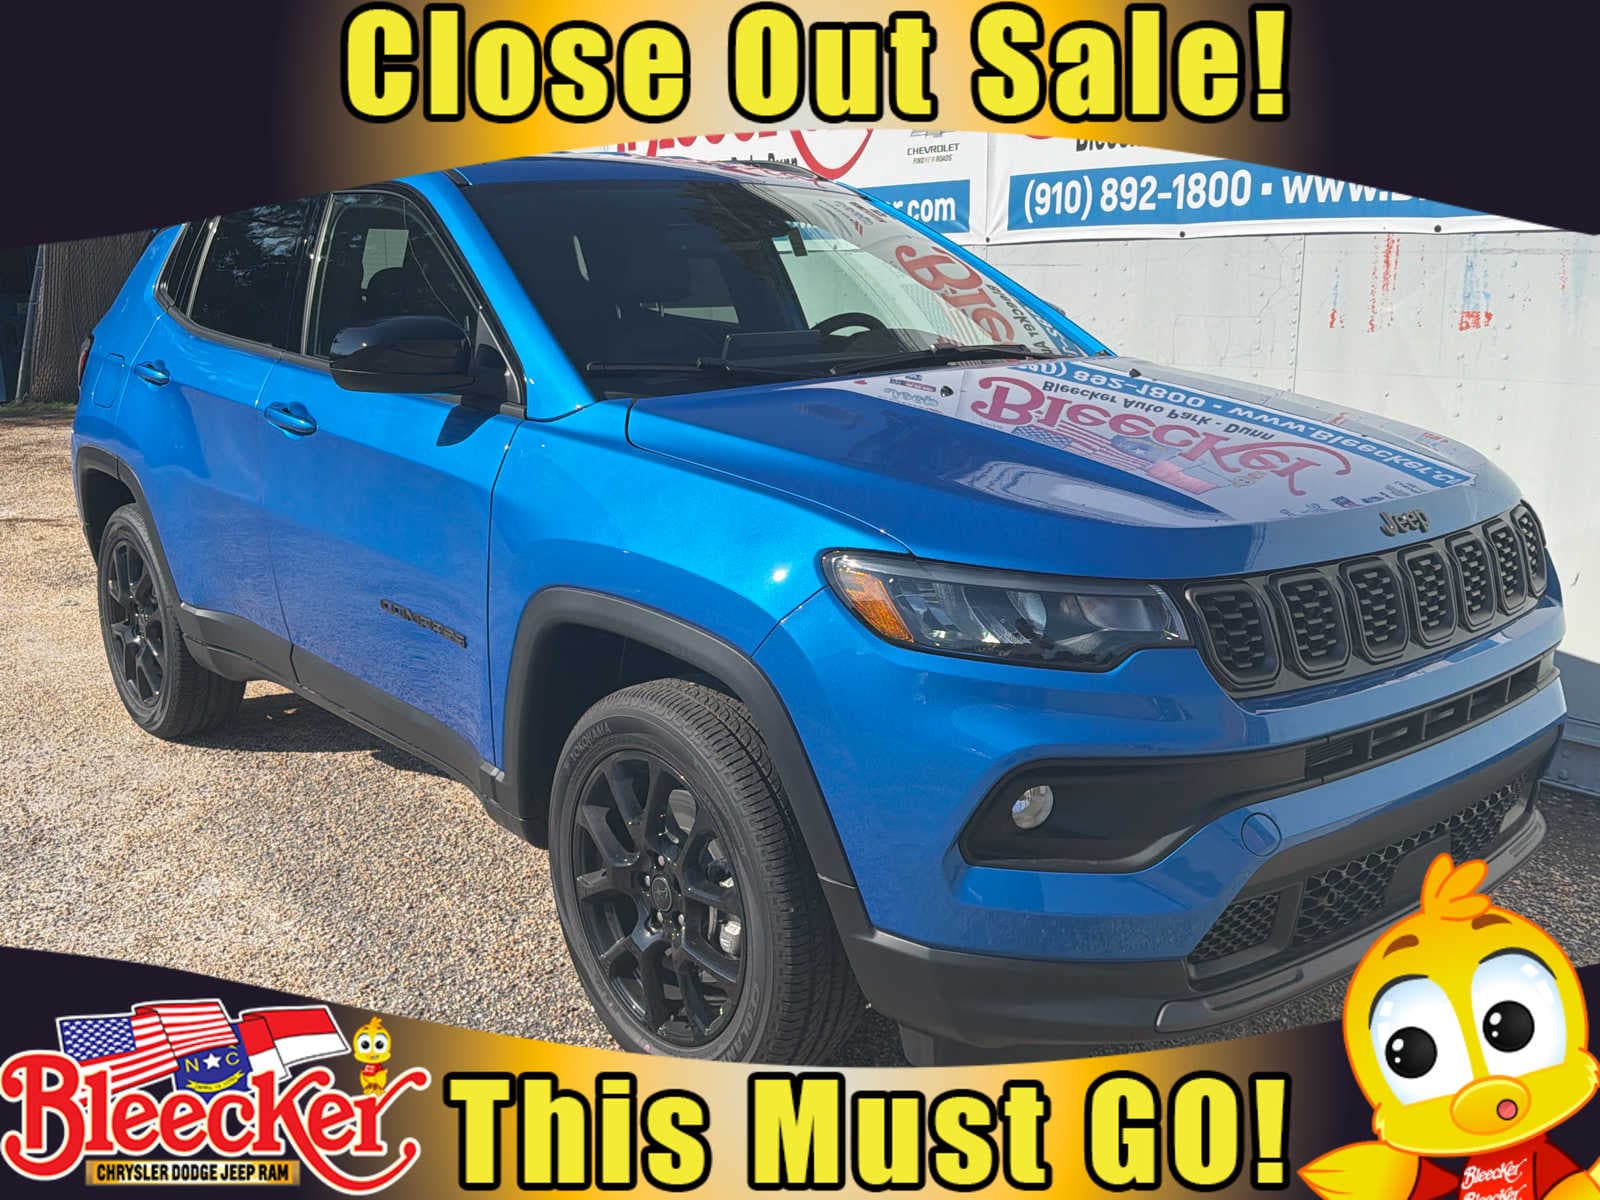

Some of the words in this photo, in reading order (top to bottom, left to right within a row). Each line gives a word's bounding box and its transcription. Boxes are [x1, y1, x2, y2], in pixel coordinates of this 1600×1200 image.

[907, 143, 960, 155] CHEVROLET
[1024, 175, 1093, 224] (910)
[1100, 169, 1252, 212] 892-1800
[1379, 509, 1430, 537] Jeep
